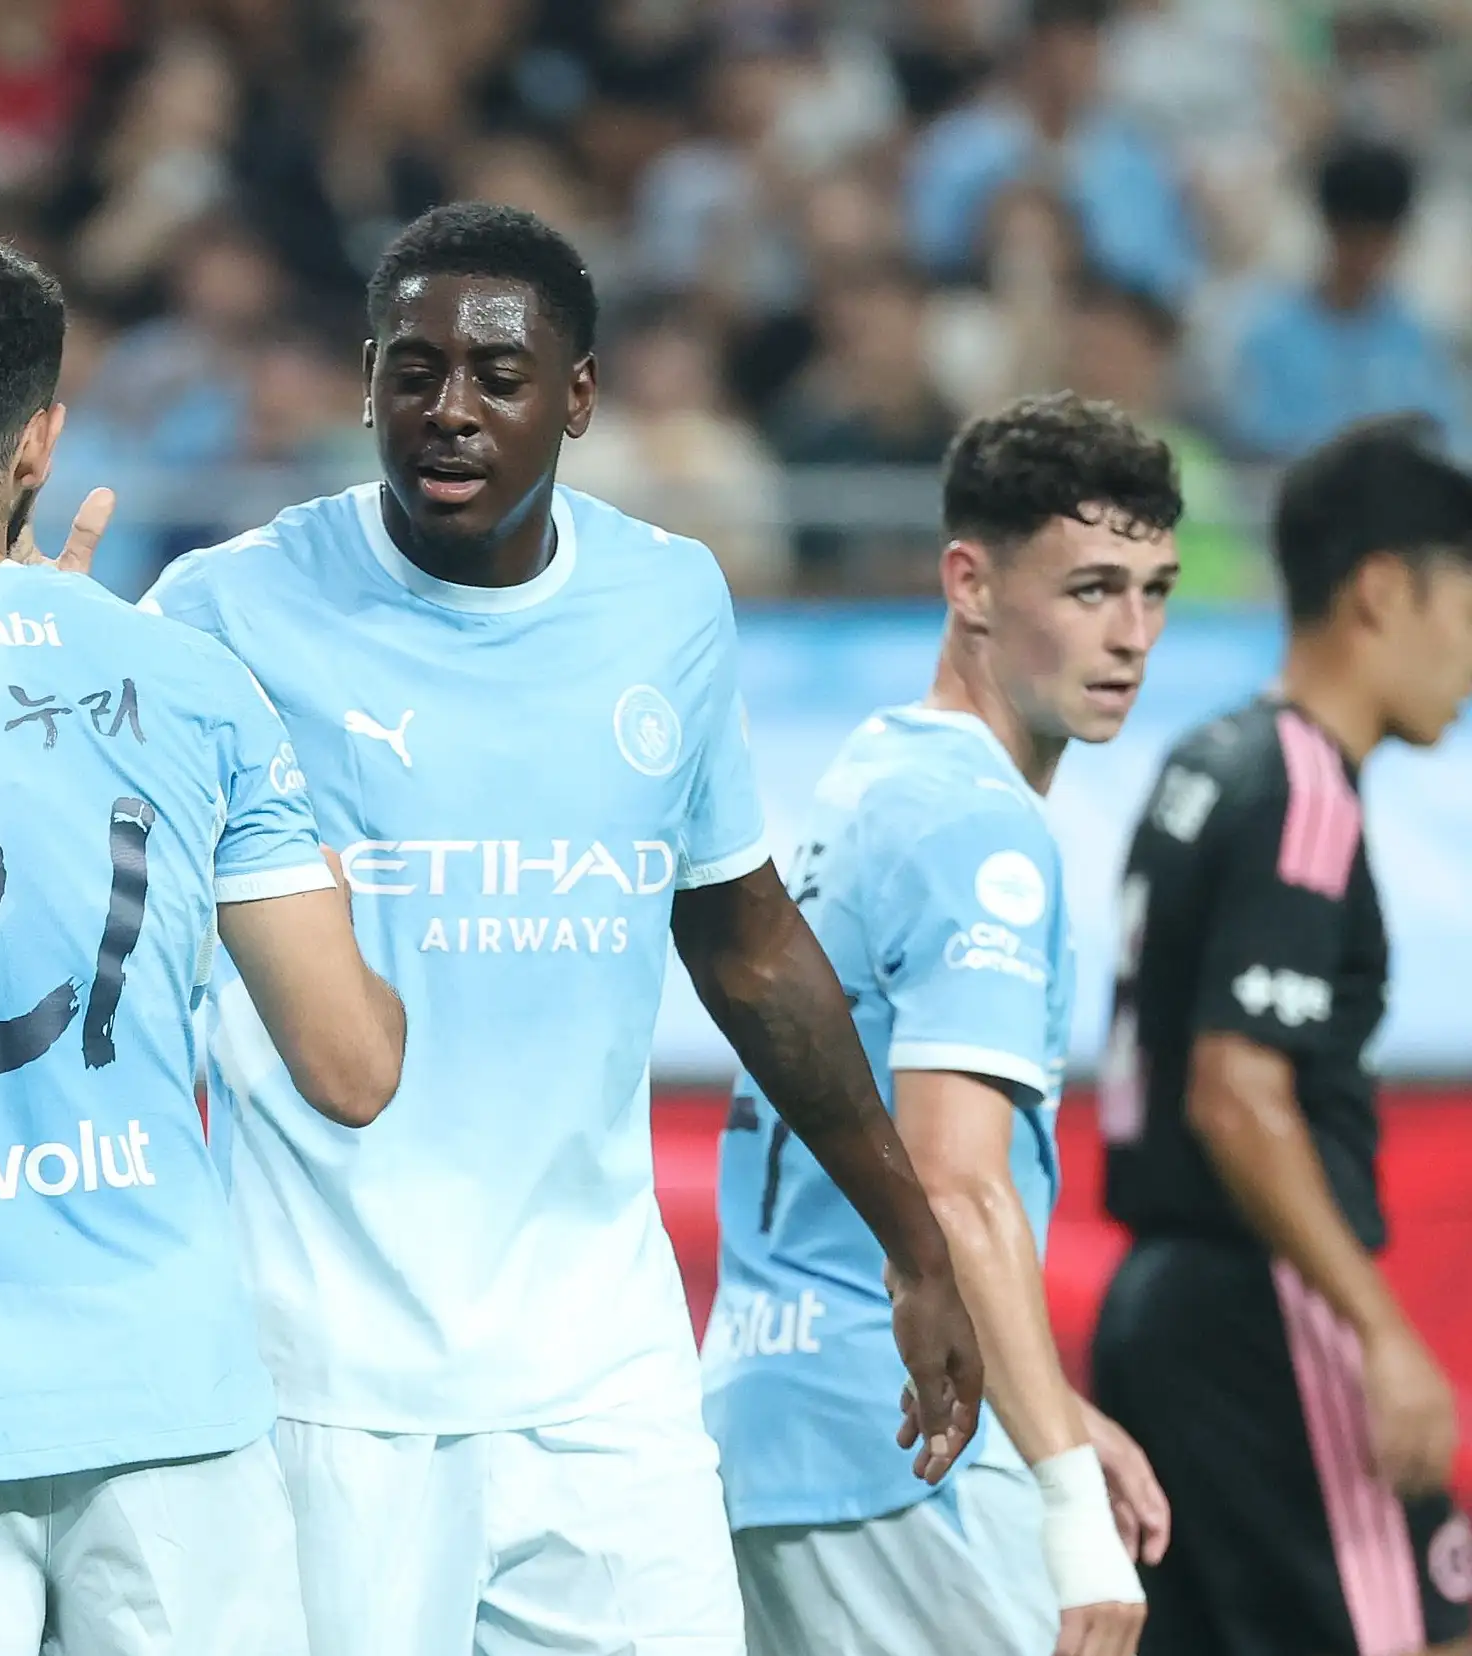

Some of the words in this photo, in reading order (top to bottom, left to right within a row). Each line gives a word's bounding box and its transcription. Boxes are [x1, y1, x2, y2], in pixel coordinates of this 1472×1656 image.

[3, 677, 148, 751] 누리
[339, 839, 676, 896] ETIHAD
[419, 916, 629, 954] AIRWAYS
